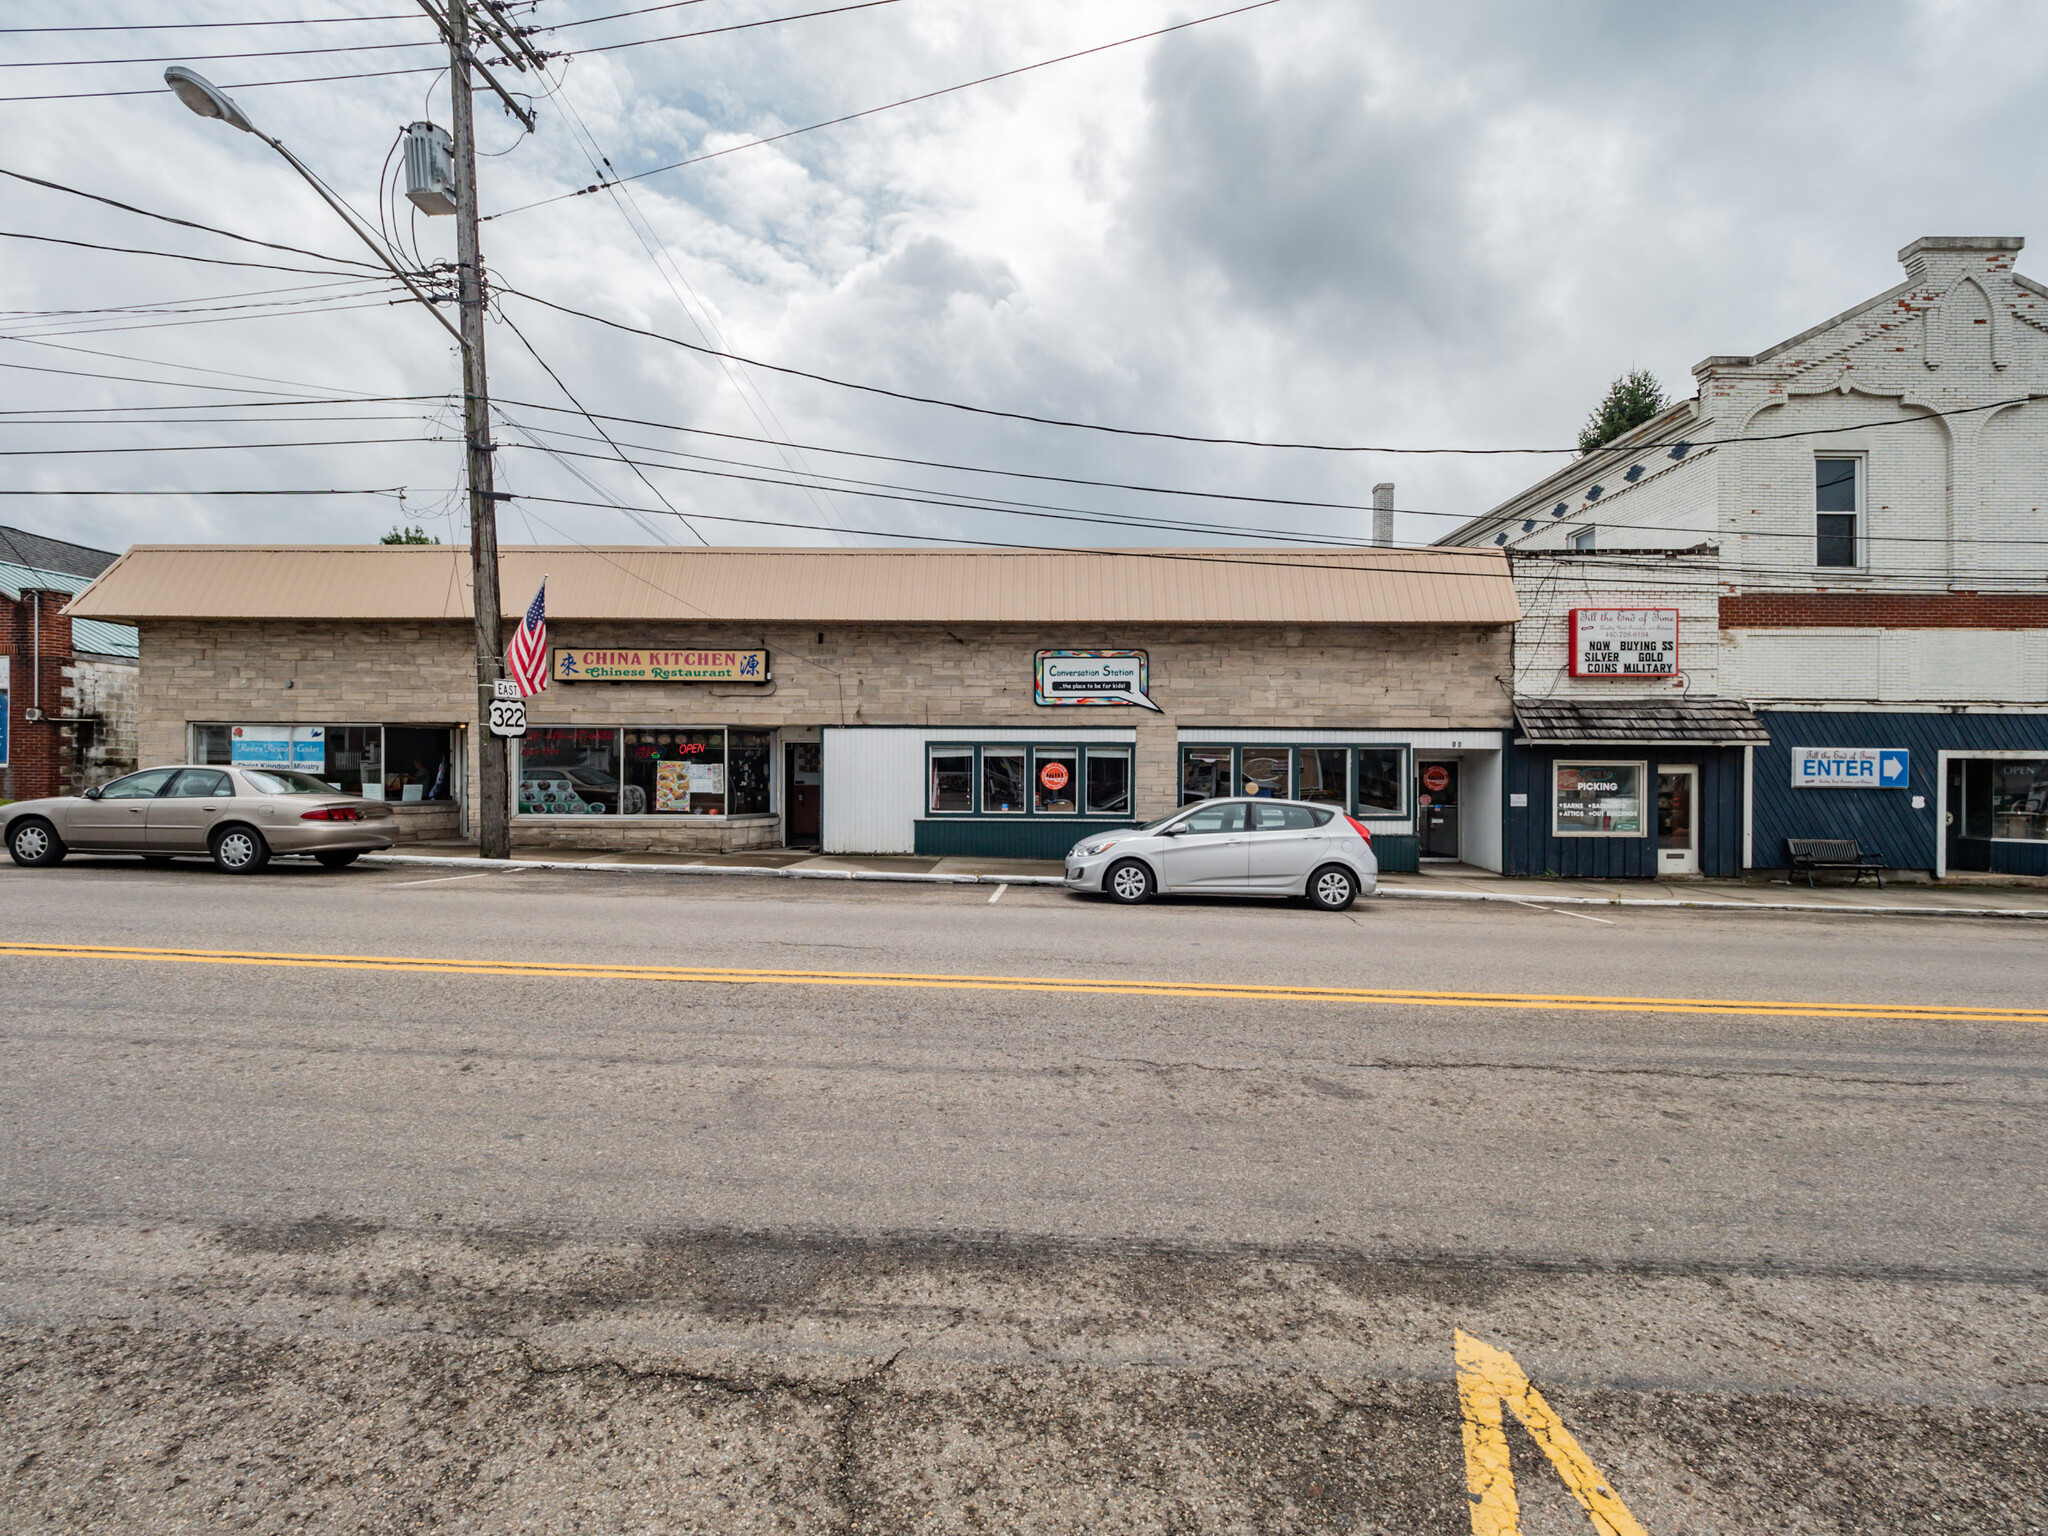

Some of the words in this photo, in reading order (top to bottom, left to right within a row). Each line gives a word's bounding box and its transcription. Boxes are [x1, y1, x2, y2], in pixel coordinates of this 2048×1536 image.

[1580, 611, 1597, 622] Till
[1601, 611, 1612, 622] the
[1617, 611, 1636, 622] End
[1639, 612, 1649, 626] of
[1652, 611, 1674, 622] Time
[1589, 641, 1611, 651] NOW
[1620, 641, 1657, 651] BUYING
[583, 651, 642, 666] CHINA
[650, 652, 736, 666] KITCHEN
[1585, 652, 1620, 662] SILVER
[1638, 652, 1664, 662] GOLD
[560, 652, 580, 676] 來
[1587, 663, 1617, 673] COINS
[1624, 663, 1673, 673] MILITARY
[585, 667, 646, 678] Chinese
[651, 667, 732, 679] Restaurant
[1049, 665, 1100, 677] Conversation
[1103, 665, 1134, 677] Station
[498, 683, 517, 696] EAST
[493, 707, 525, 728] 322
[297, 743, 320, 753] Center
[679, 744, 706, 755] OPEN
[277, 752, 283, 760] A
[1806, 750, 1819, 760] Till
[1821, 751, 1831, 760] the
[1833, 750, 1847, 760] End
[1849, 751, 1856, 761] of
[1860, 750, 1876, 760] Time
[294, 762, 320, 771] Ministry
[1804, 759, 1874, 777] ENTER
[2003, 766, 2035, 775] OPEN
[1577, 782, 1618, 791] PICKING
